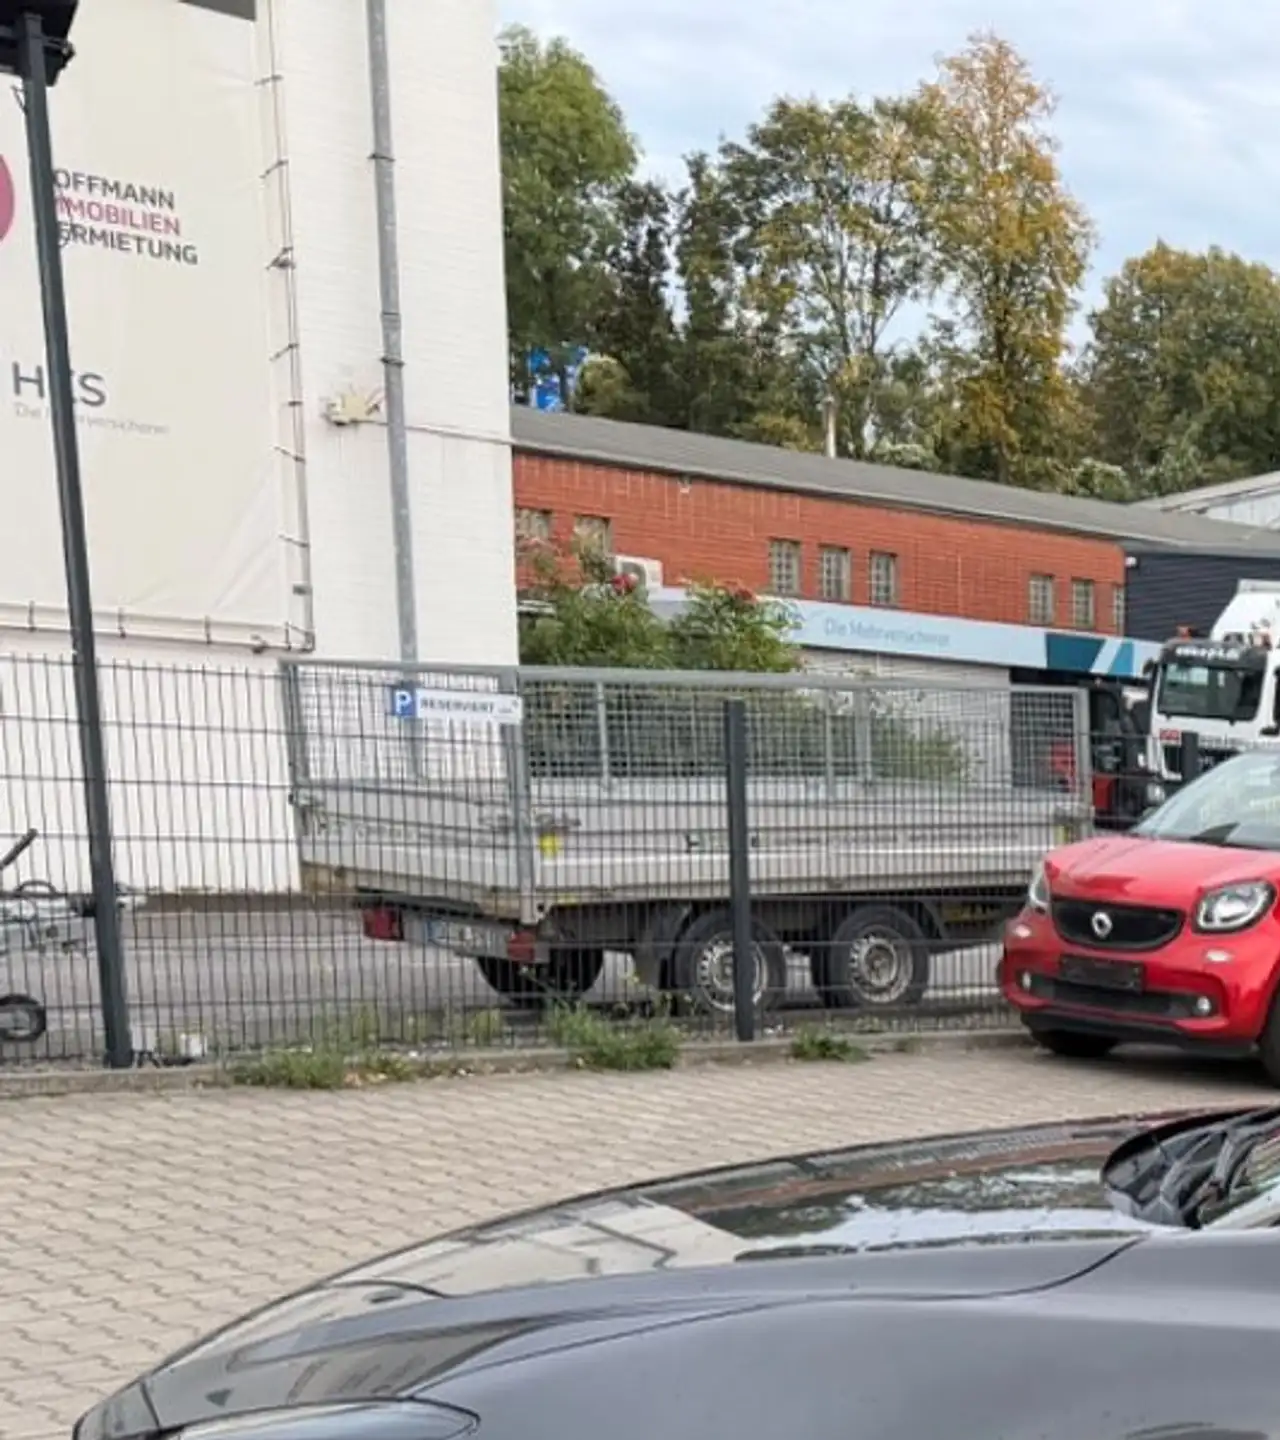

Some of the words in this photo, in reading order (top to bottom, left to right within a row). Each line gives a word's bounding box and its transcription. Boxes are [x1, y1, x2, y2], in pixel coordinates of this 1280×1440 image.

[53, 168, 175, 210] OFFMANN
[58, 220, 199, 265] ERMIETUNG
[12, 361, 107, 407] HS
